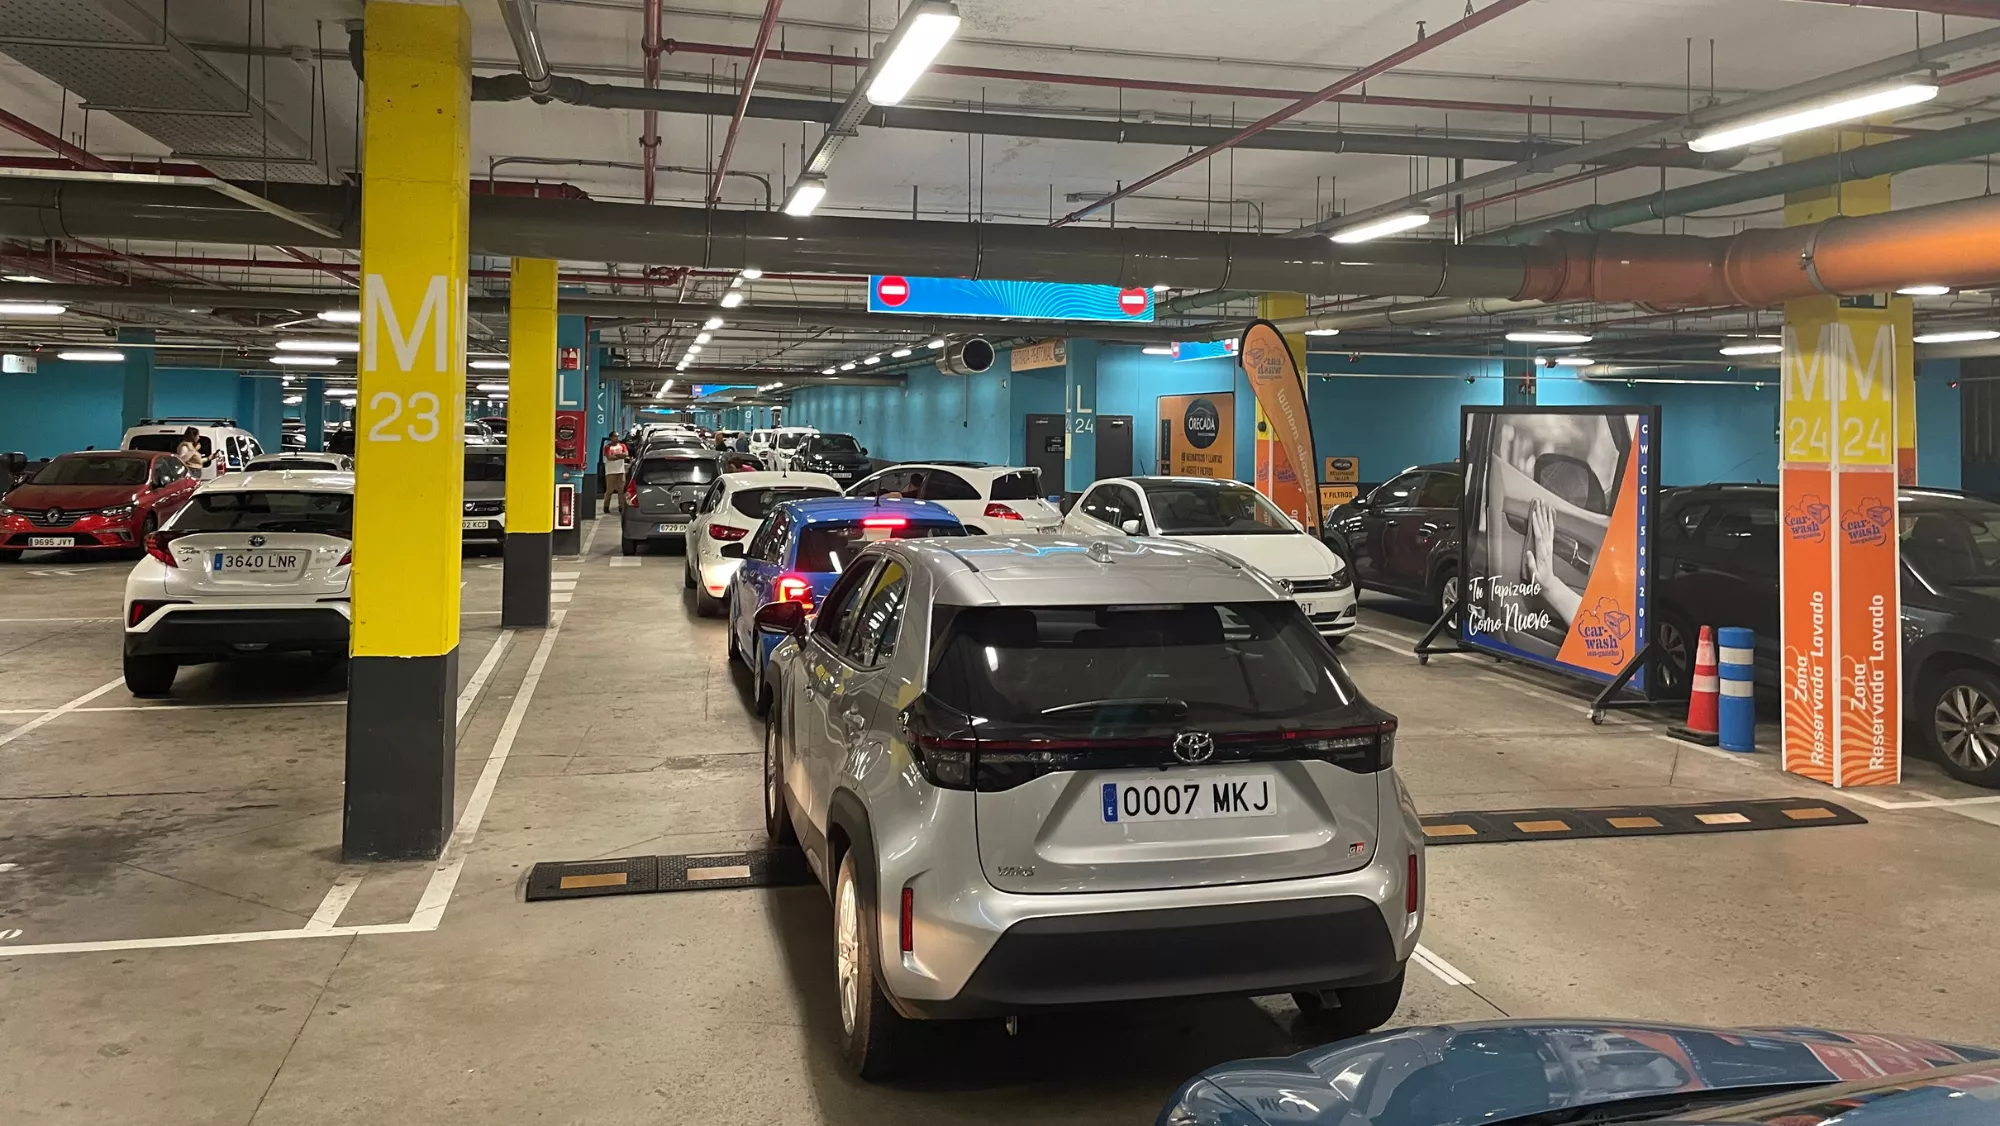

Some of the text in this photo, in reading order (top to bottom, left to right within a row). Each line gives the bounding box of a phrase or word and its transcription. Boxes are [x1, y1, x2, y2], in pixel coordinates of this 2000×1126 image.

[365, 274, 448, 372] M
[1785, 325, 1831, 401] M
[1838, 324, 1891, 401] M
[559, 374, 578, 406] L
[1076, 384, 1092, 413] L
[369, 391, 440, 442] 23
[1075, 418, 1094, 434] 24
[1789, 416, 1827, 457] 24
[1843, 416, 1886, 457] 24
[1328, 491, 1353, 499] FILTROS
[1791, 521, 1820, 534] wash
[1848, 524, 1880, 539] wash
[225, 555, 297, 568] 3640 LNR
[1468, 572, 1542, 607] Tu Tapizado
[1301, 603, 1313, 613] GT
[1468, 602, 1551, 636] Como Nuevo
[1585, 634, 1619, 649] wash
[1794, 655, 1808, 703] Zona
[1810, 590, 1824, 767] Reservada Lavado
[1851, 663, 1866, 711] Zona
[1868, 594, 1884, 769] Reservada Lavado
[1107, 807, 1114, 816] E
[1123, 781, 1269, 816] 0007 MKJ
